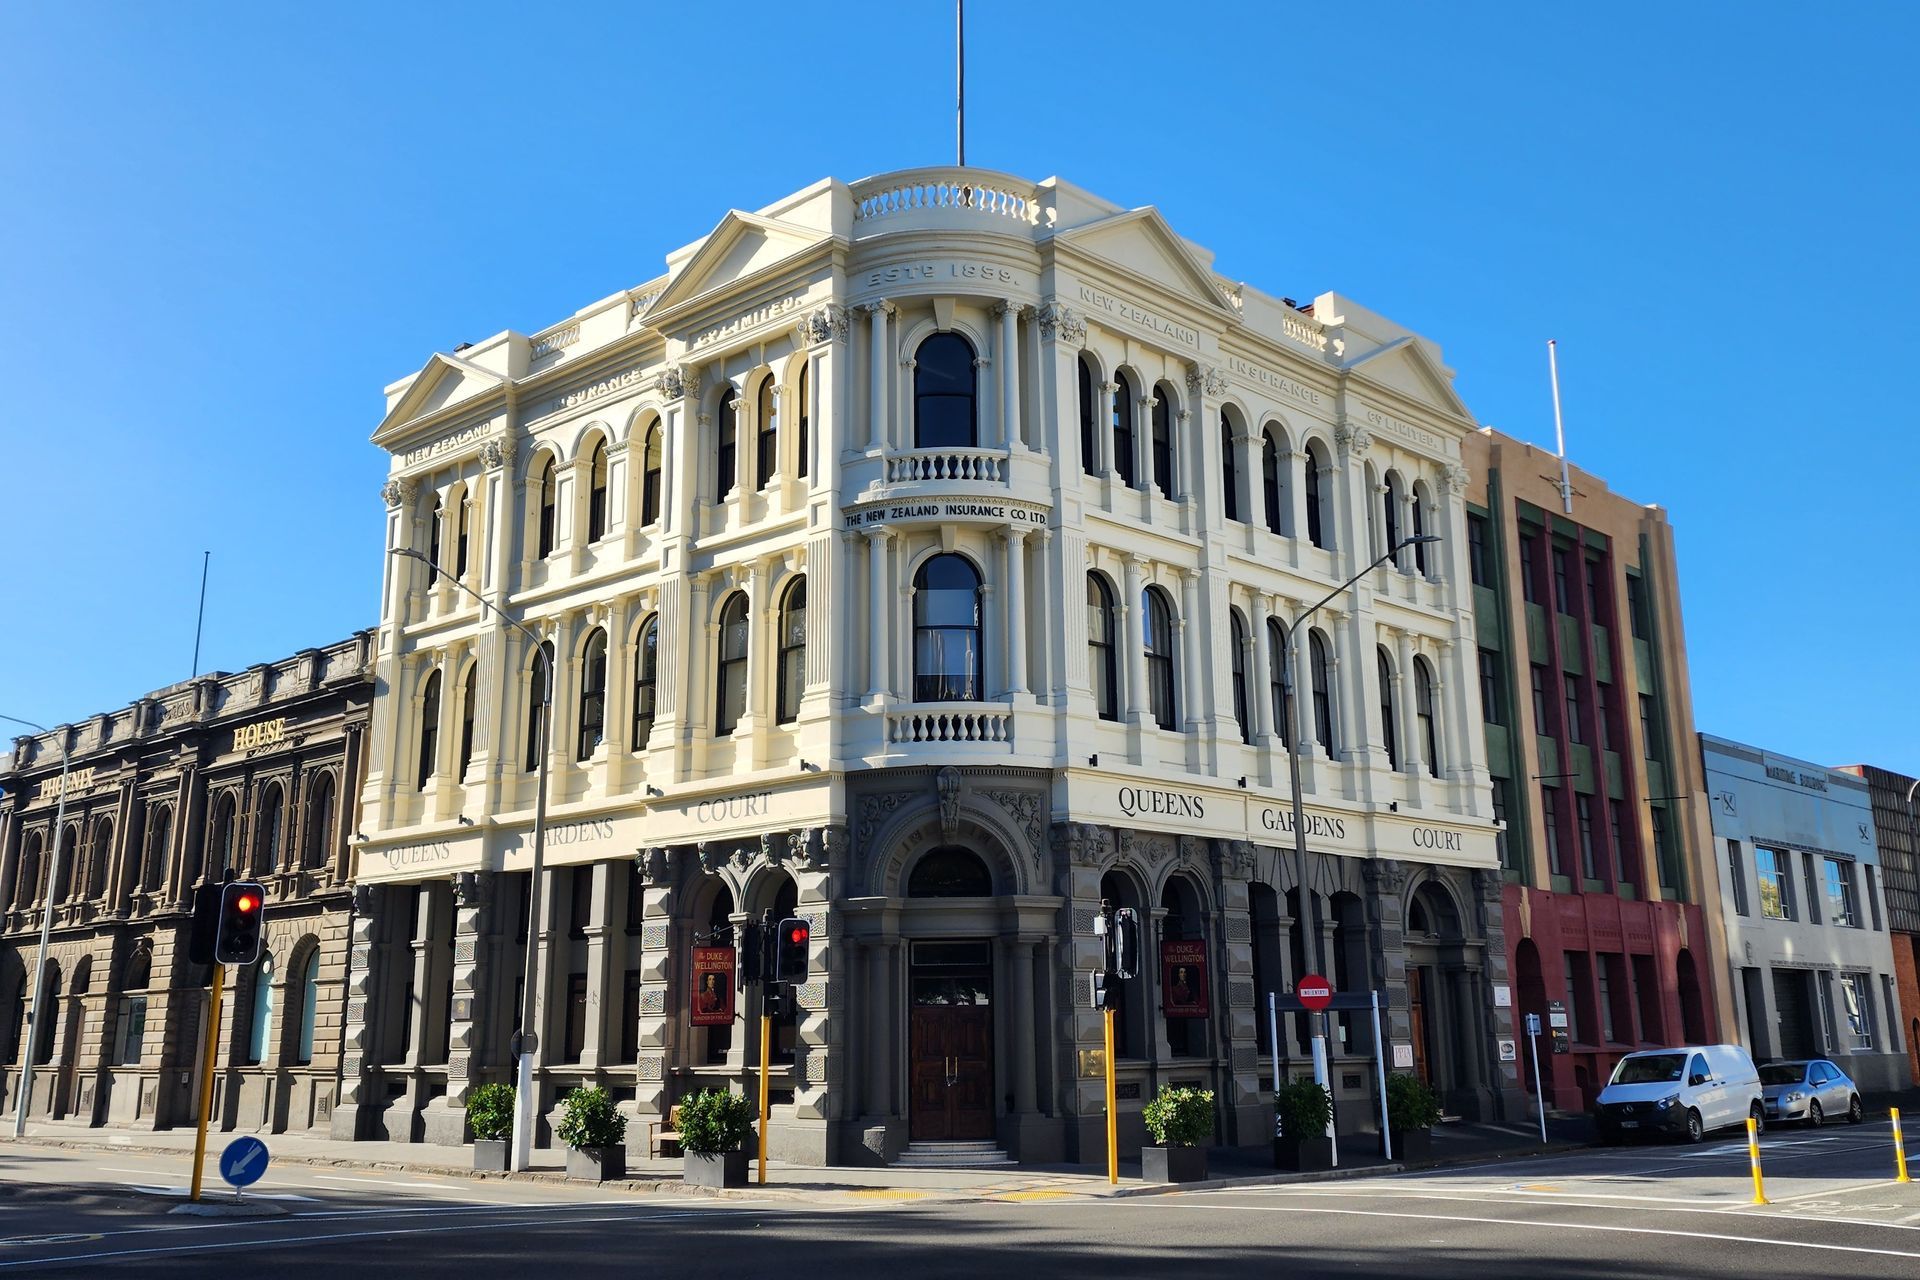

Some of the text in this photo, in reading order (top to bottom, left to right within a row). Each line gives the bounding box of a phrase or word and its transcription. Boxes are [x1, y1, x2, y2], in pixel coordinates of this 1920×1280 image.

[1080, 286, 1194, 345] NEW ZEALAND
[552, 367, 643, 412] INSURANCE
[1229, 357, 1320, 405] INSURANCE
[405, 422, 491, 468] NEW ZEALAND
[846, 504, 1047, 527] THE NEW ZEALAND INSURANCE CO. LTD.
[232, 717, 286, 752] HOUSE
[696, 791, 773, 824] COURT
[1118, 787, 1205, 819] QUEENS
[1261, 808, 1346, 840] GARDENS
[1412, 827, 1462, 851] COURT
[389, 840, 450, 871] QUEENS
[694, 961, 733, 970] WELLINGTON
[706, 952, 723, 961] DUKE
[1164, 954, 1205, 963] WELLINGTON
[1176, 945, 1194, 954] DUKE
